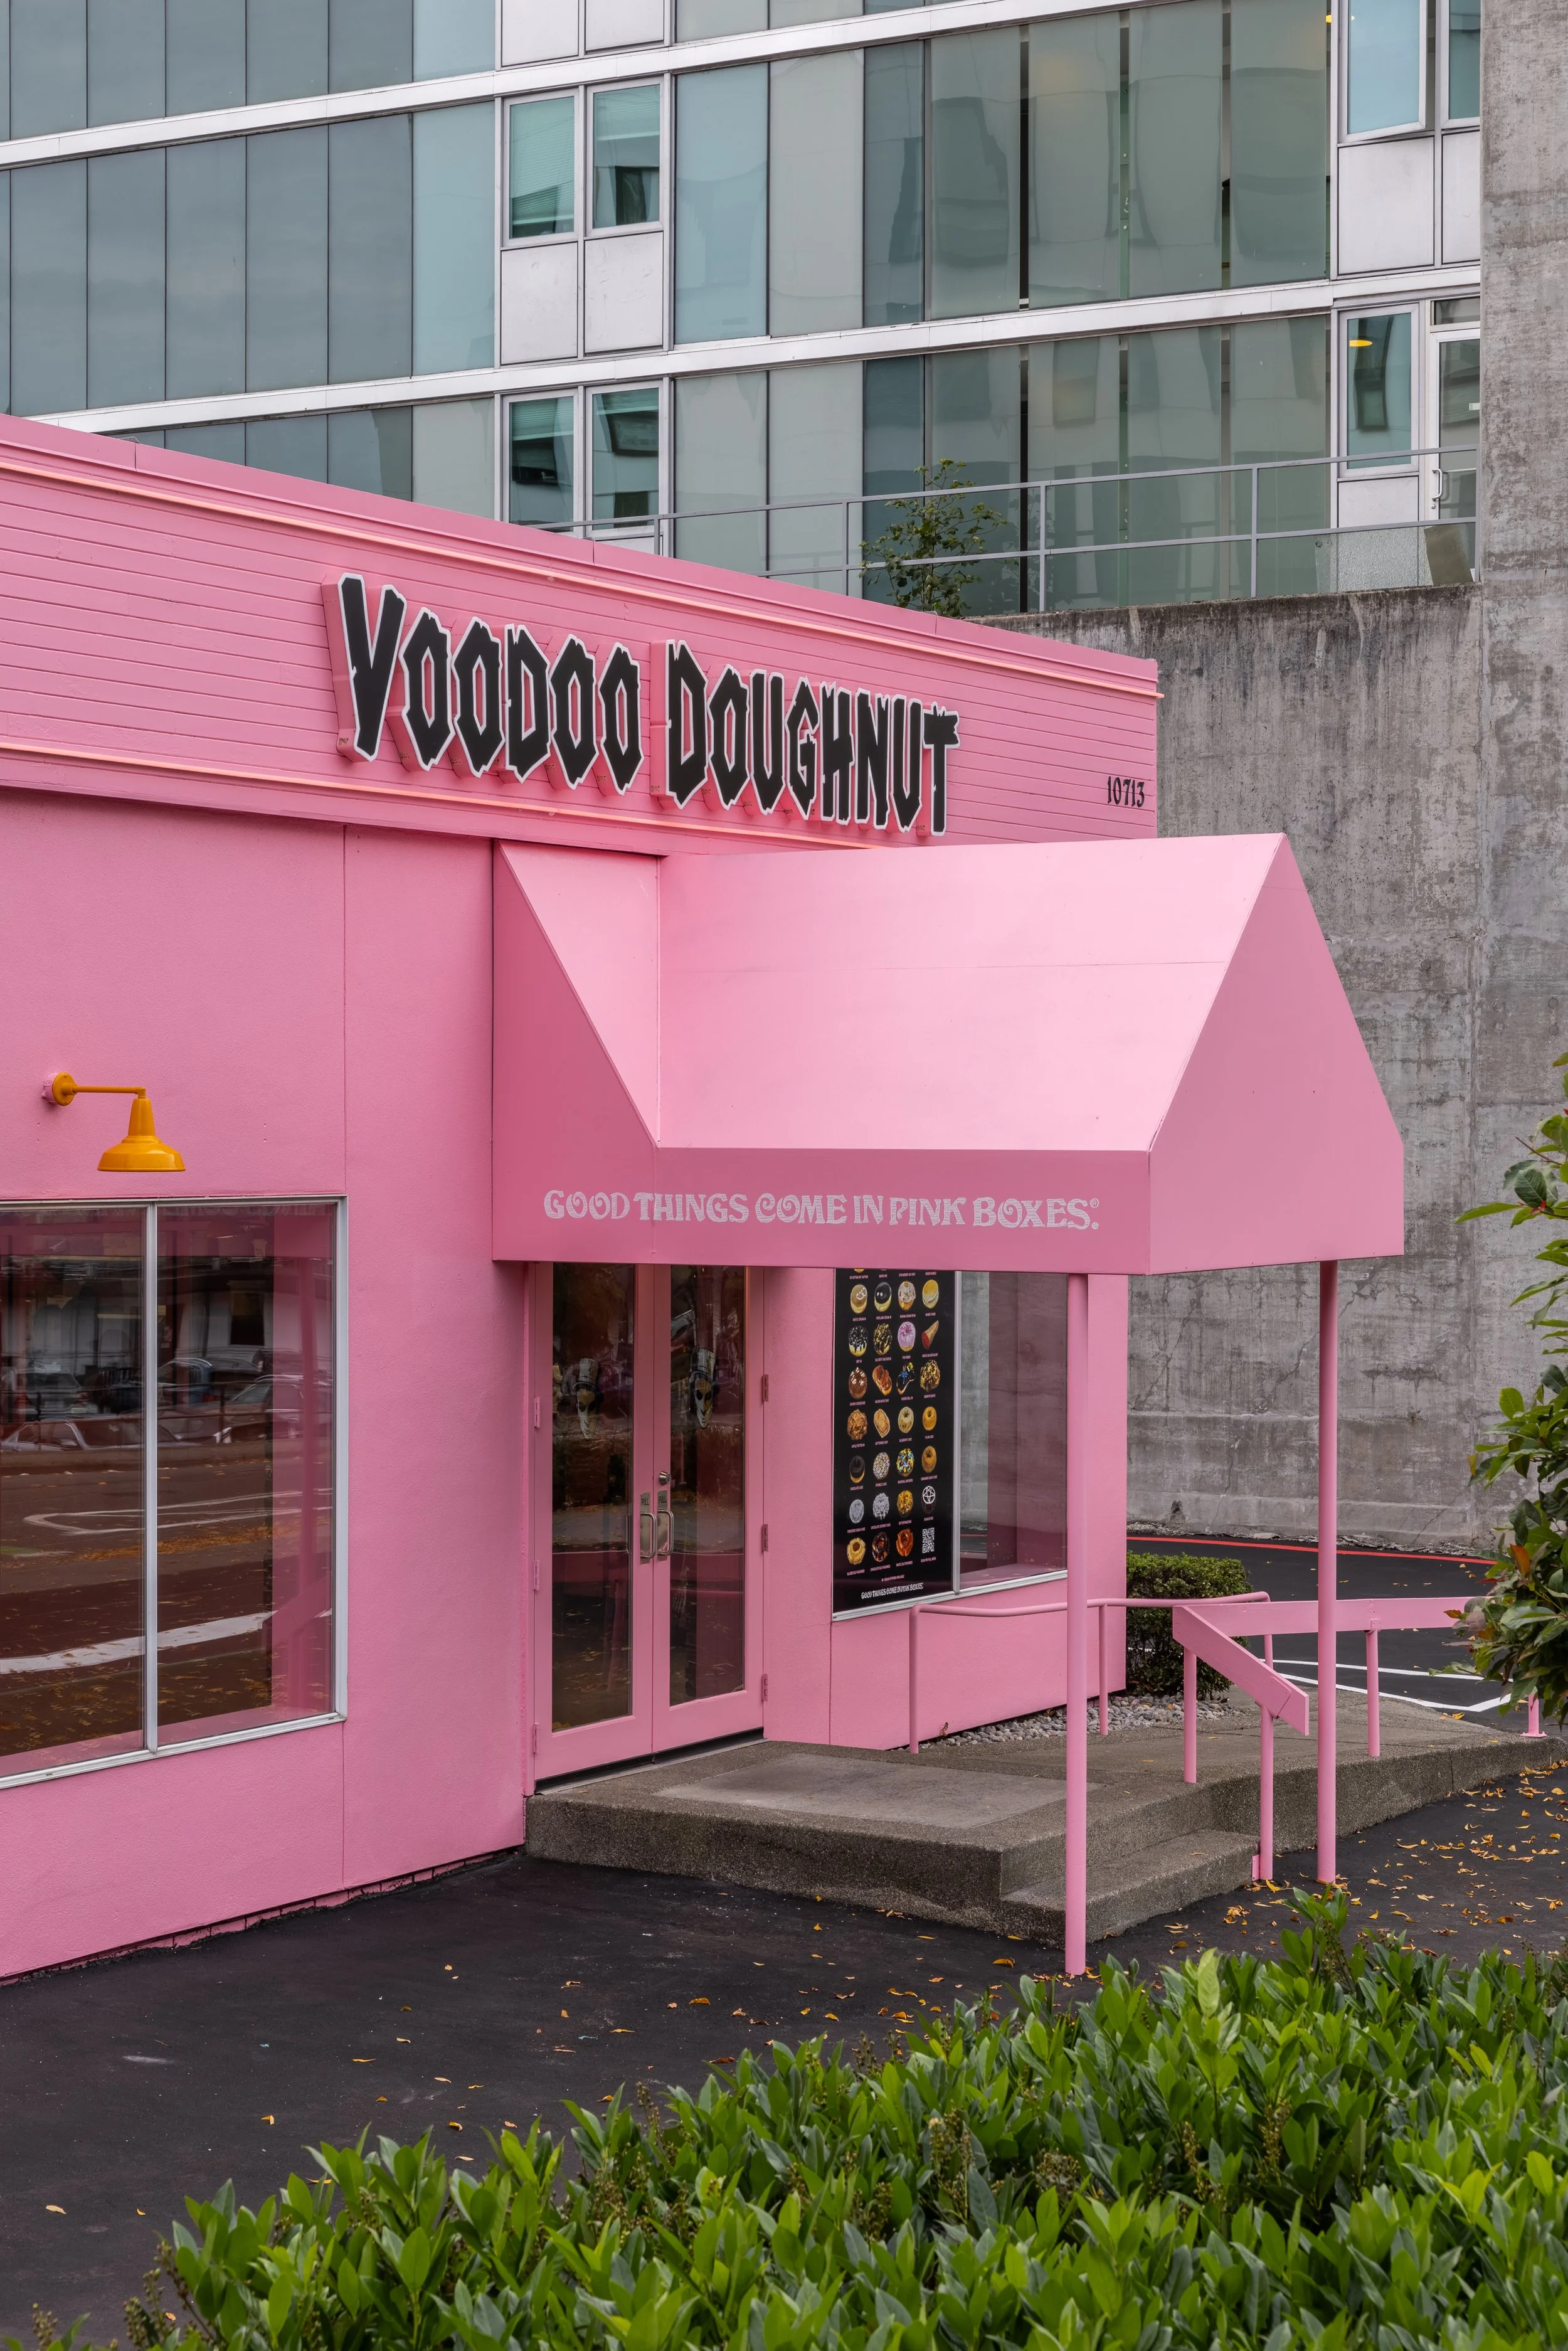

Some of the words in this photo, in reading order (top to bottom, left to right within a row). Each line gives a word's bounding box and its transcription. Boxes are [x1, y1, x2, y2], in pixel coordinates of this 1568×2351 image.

[337, 572, 644, 796] VOODOO
[665, 639, 961, 836] DOUGHNUT
[1107, 776, 1145, 808] 10713
[544, 1190, 630, 1219] GOOD
[633, 1192, 750, 1223] THINGS
[755, 1193, 847, 1224] COME
[853, 1195, 883, 1224] IN
[889, 1197, 967, 1226] PINK
